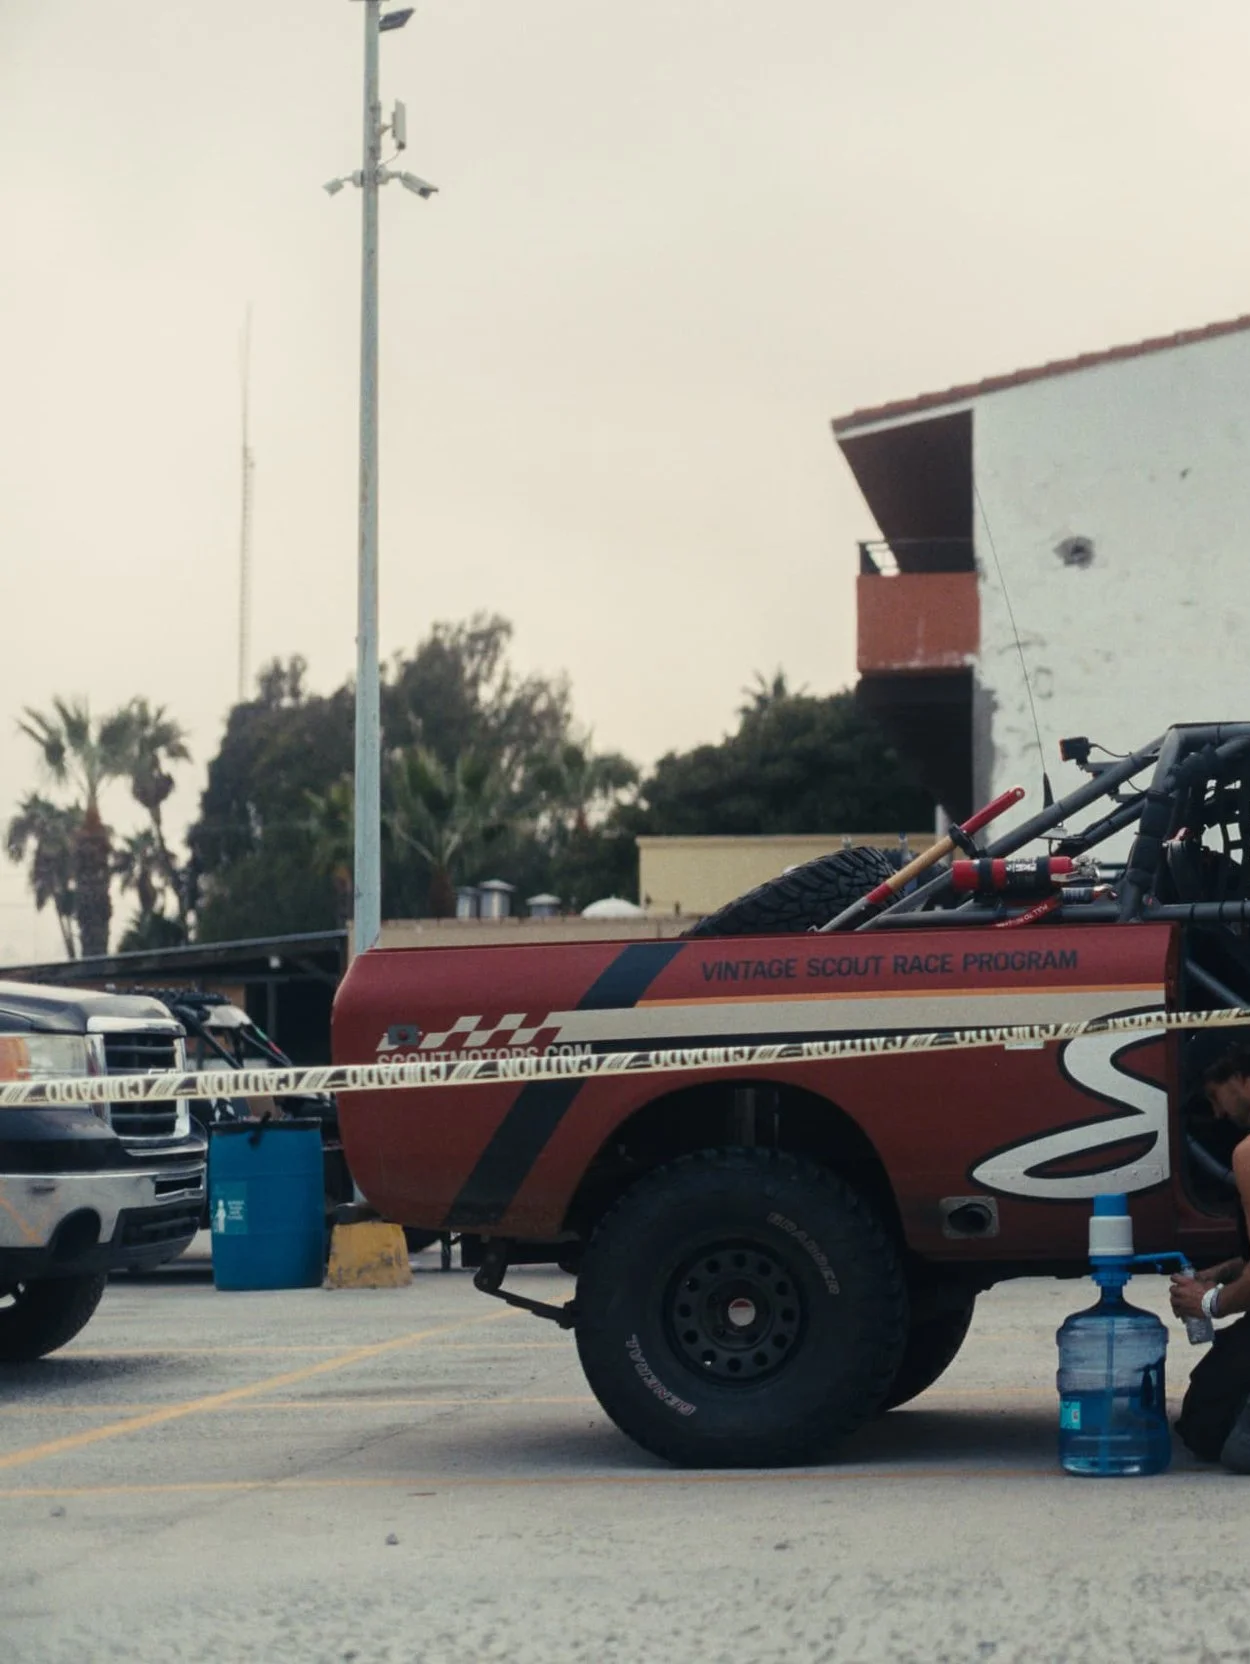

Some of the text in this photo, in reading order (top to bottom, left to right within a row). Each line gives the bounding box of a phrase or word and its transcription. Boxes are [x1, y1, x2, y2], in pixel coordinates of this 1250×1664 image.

[702, 948, 1078, 983] VINTAGE SCOUT RACE PROGRAM
[377, 1043, 592, 1065] SCOUTMOTORSCOM
[650, 1047, 750, 1067] CUIDADO
[346, 1063, 448, 1088] CUIDADO
[499, 1055, 598, 1079] CAUTION
[46, 1076, 144, 1102] CUIDADO
[196, 1070, 296, 1096] CAUTION
